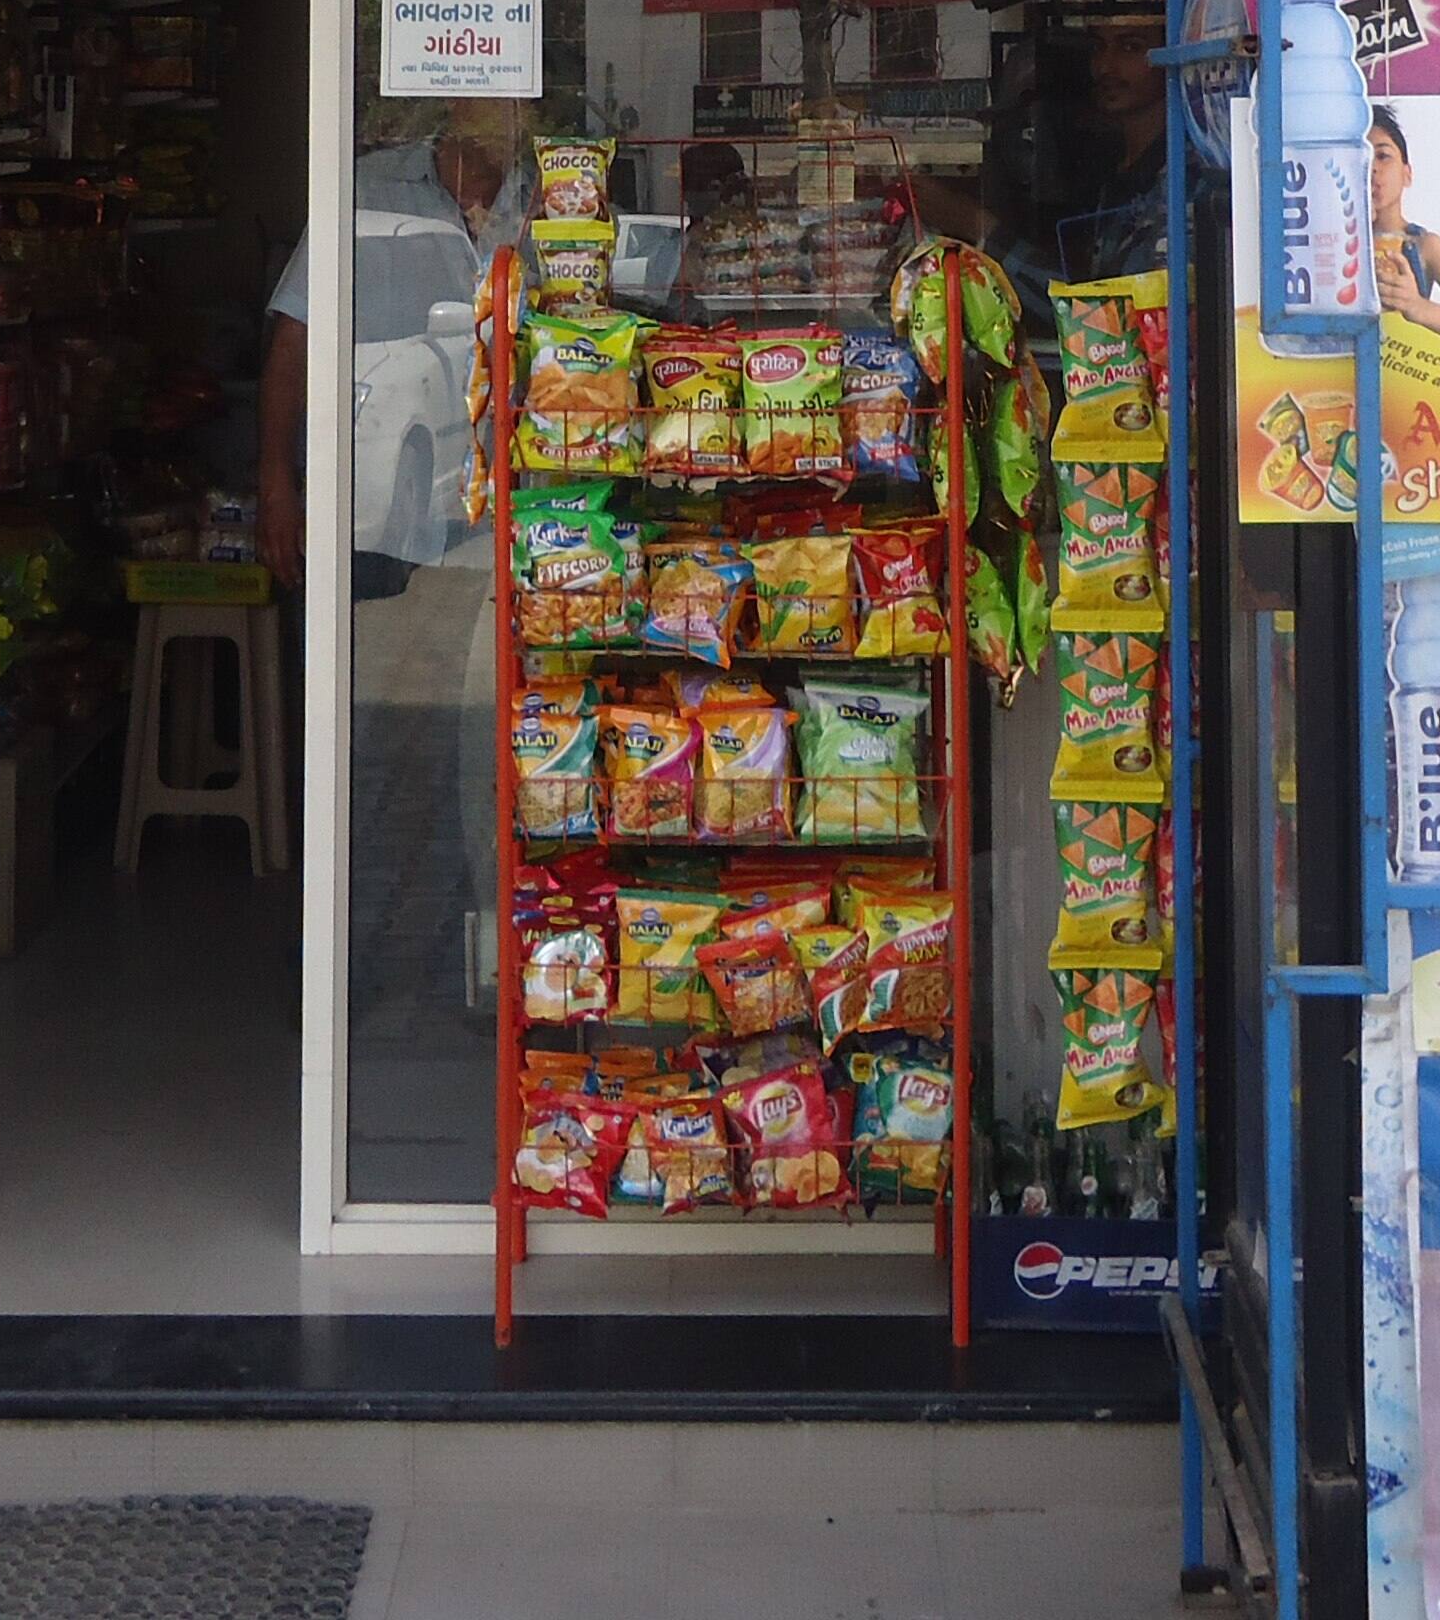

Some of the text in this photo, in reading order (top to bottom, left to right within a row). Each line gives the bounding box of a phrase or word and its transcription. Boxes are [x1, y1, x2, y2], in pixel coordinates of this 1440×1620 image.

[395, 3, 531, 22] ભાવનગર ના
[1349, 8, 1419, 49] ain
[424, 28, 501, 55] ગાંઠીયા
[1380, 336, 1412, 357] very
[750, 353, 799, 376] पुरोहित
[1380, 355, 1429, 382] licious
[1067, 370, 1098, 390] MAD
[1067, 541, 1099, 559] MAD
[840, 707, 897, 724] BALAJI
[1066, 711, 1099, 729] MAD
[629, 925, 671, 936] BALAJI
[1056, 1257, 1218, 1288] PEPI
